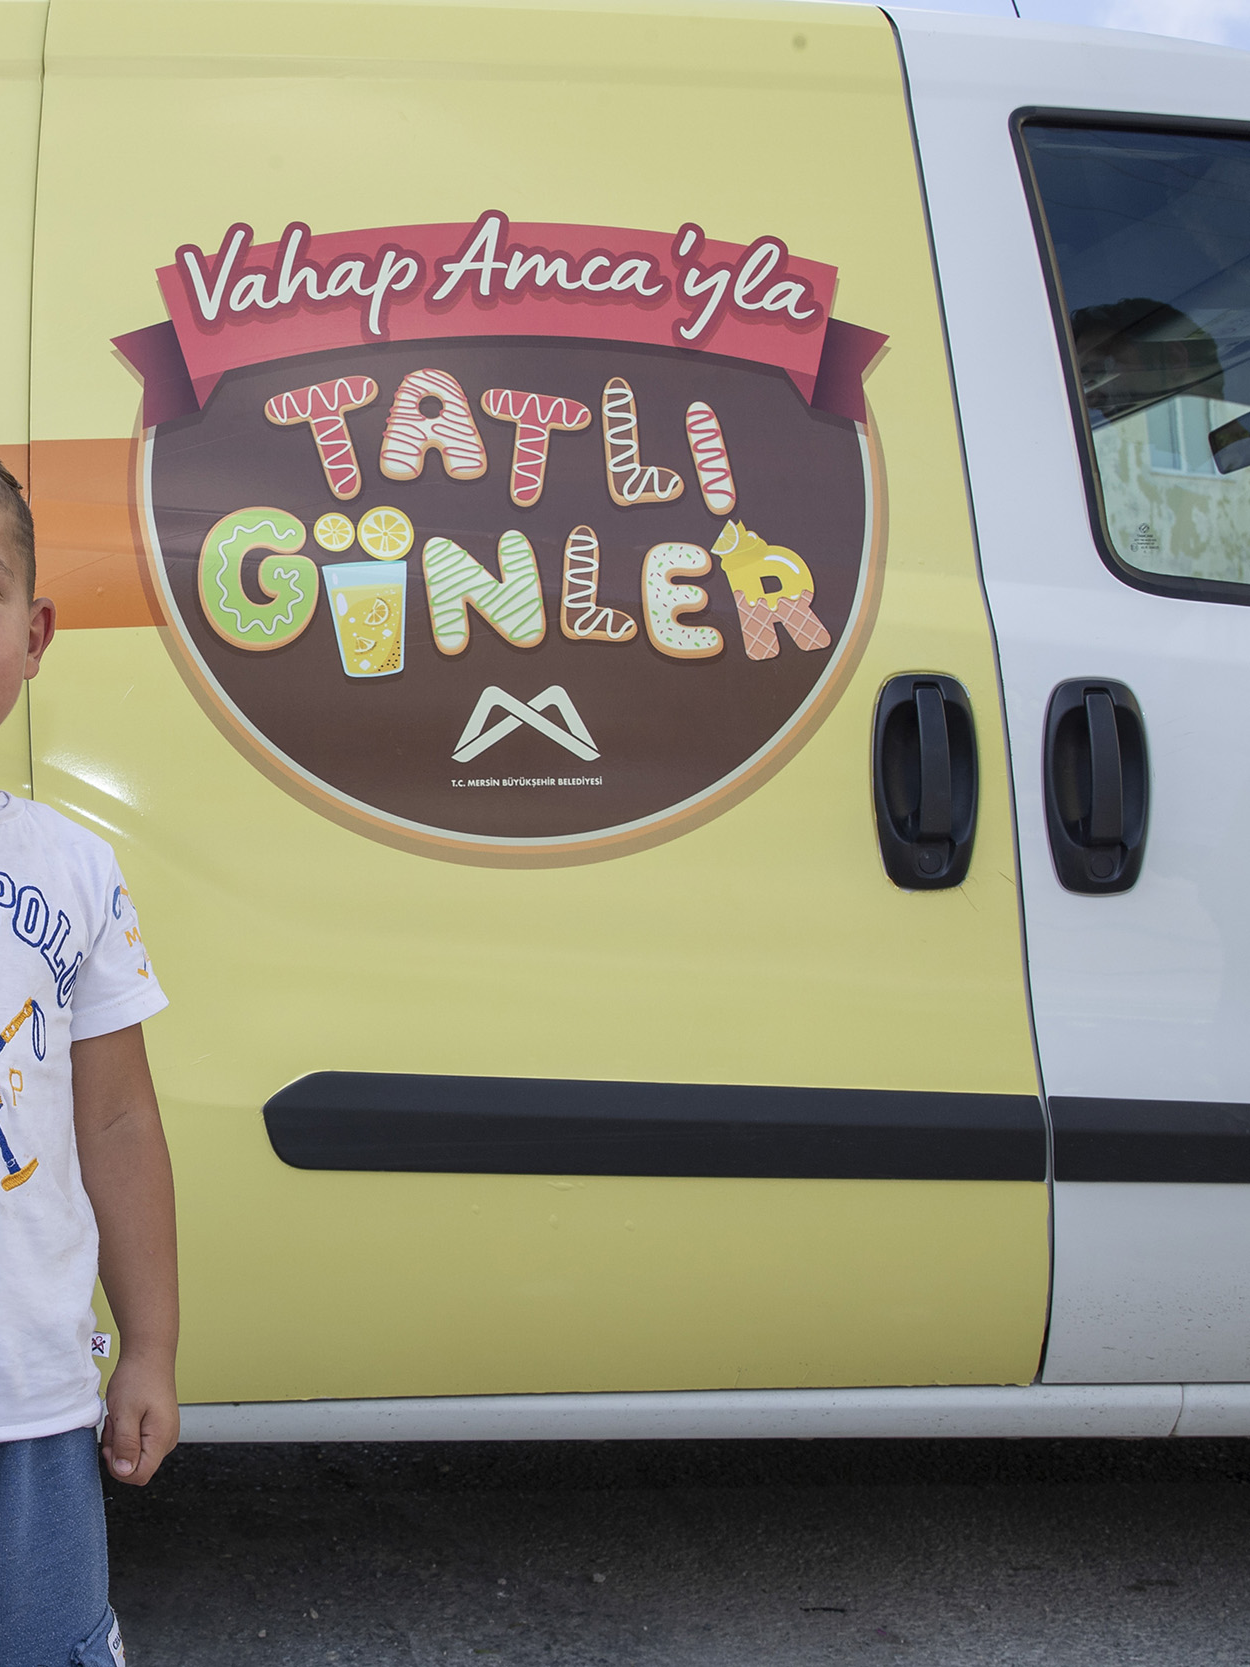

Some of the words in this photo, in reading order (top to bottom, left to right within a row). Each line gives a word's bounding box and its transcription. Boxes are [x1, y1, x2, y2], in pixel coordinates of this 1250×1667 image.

[180, 226, 419, 337] Vahap
[432, 214, 817, 341] Amca'yla
[264, 368, 737, 515] TATLI
[451, 779, 466, 787] T.C.
[467, 777, 500, 787] MERSİN
[502, 776, 556, 788] BÜYÜKŞEHİR
[558, 776, 603, 786] BELEDİYESİ
